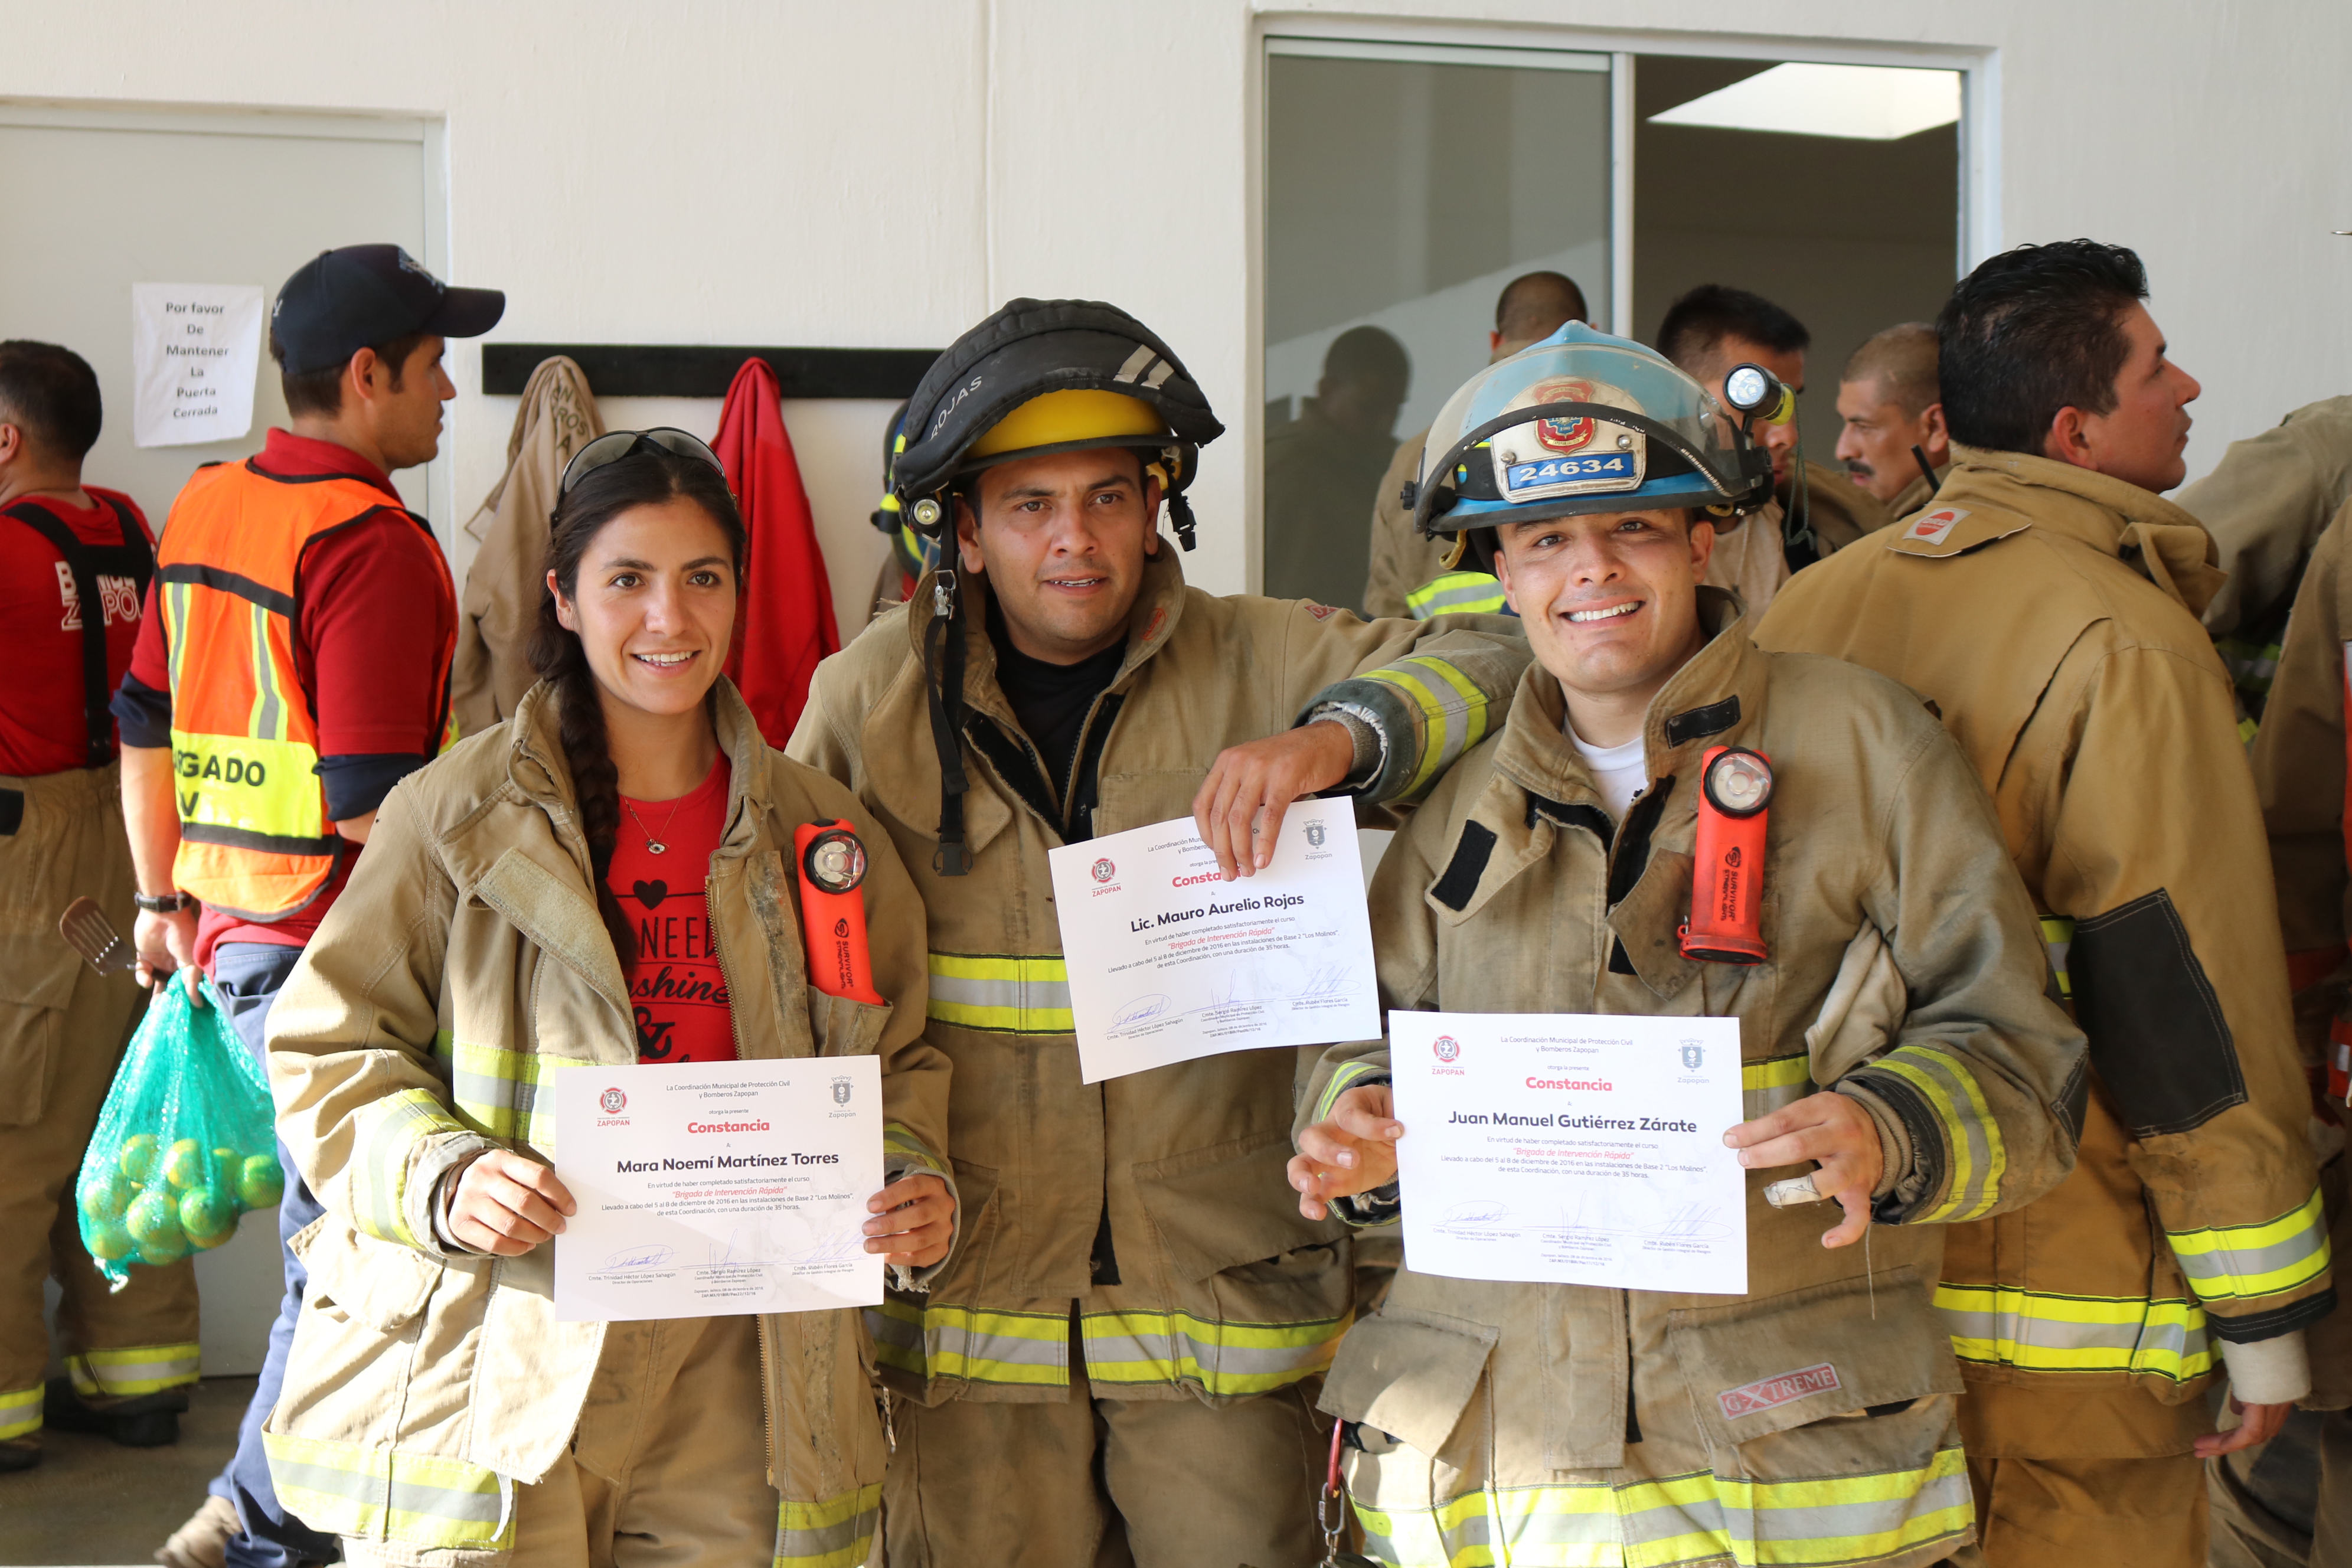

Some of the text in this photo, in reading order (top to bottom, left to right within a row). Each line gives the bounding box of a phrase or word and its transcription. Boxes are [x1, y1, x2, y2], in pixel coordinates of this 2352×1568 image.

[166, 302, 225, 315] Por favor
[187, 324, 204, 335] De
[166, 344, 230, 356] Mantener
[191, 366, 204, 377] La
[177, 387, 216, 398] Puerta
[173, 404, 218, 418] Cerrada
[1519, 458, 1625, 482] 24634
[1154, 838, 1188, 851] Coordinación
[1092, 884, 1122, 897] ZAPOPAN
[1131, 893, 1305, 933] Lic. Mauro Aurelio Rojas
[1152, 935, 1168, 943] virtud
[1191, 924, 1223, 935] completado
[1223, 918, 1274, 929] satisfactoriamente
[1197, 936, 1206, 945] de
[1207, 930, 1247, 943] Intervención
[1549, 1037, 1579, 1045] Municipal
[1573, 1046, 1599, 1054] Zapopan
[674, 1083, 711, 1091] Coordinación
[711, 1082, 739, 1090] Municipal
[1525, 1076, 1613, 1092] Constancia
[1677, 1077, 1710, 1085] Zapopan
[687, 1118, 770, 1134] Constancia
[1448, 1110, 1697, 1133] Juan Manuel Gutiérrez Zárate
[1577, 1140, 1634, 1148] satisfactoriamente
[1546, 1148, 1556, 1157] de
[1557, 1149, 1603, 1158] Intervención
[617, 1152, 839, 1173] Mara Noemí Martínez Torres
[699, 1178, 733, 1187] completado
[733, 1177, 788, 1185] satisfactoriamente
[704, 1188, 714, 1197] de
[714, 1187, 757, 1197] Intervención
[1725, 1370, 1835, 1412] G-XTREME
